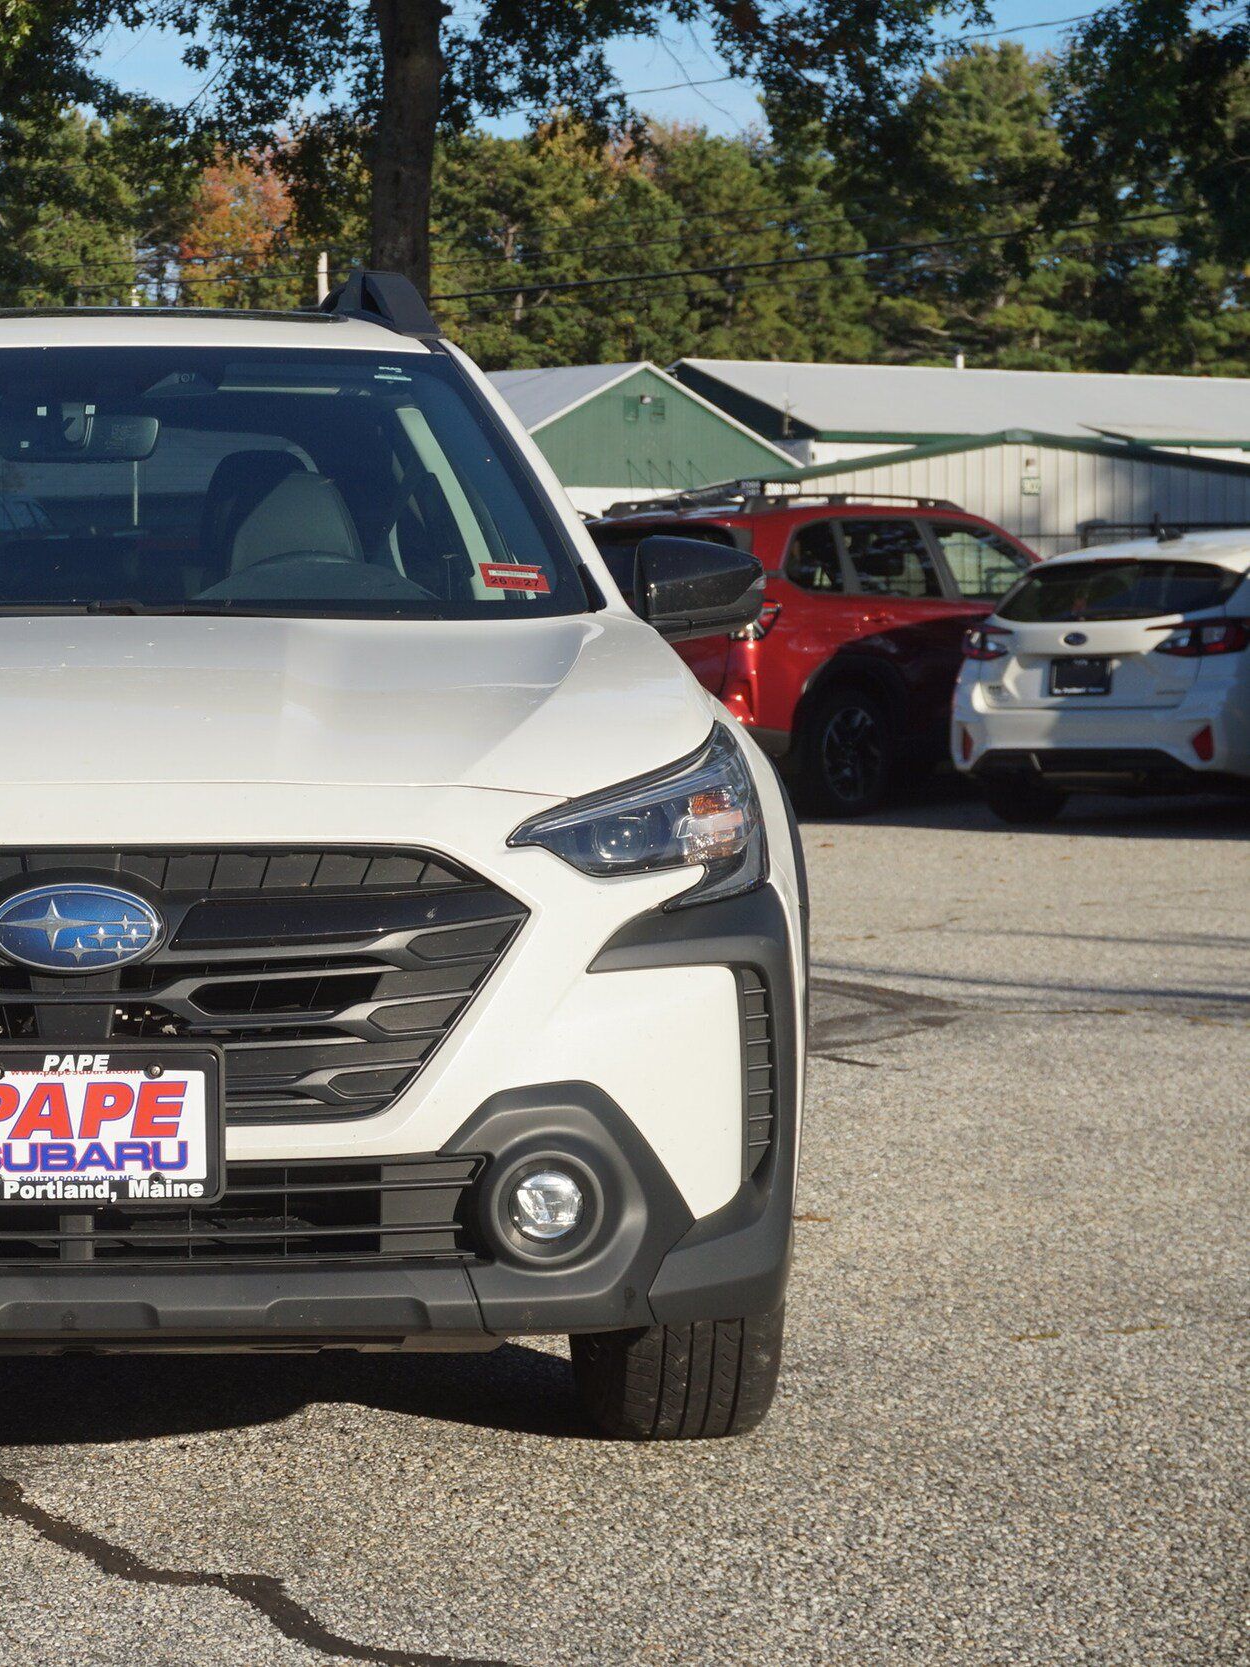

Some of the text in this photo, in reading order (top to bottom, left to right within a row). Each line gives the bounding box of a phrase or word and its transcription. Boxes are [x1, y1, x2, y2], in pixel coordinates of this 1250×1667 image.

[42, 1054, 110, 1072] PAPE
[59, 1174, 115, 1182] PORTLAND
[3, 1180, 117, 1203] Portland,
[128, 1178, 204, 1199] Maine
